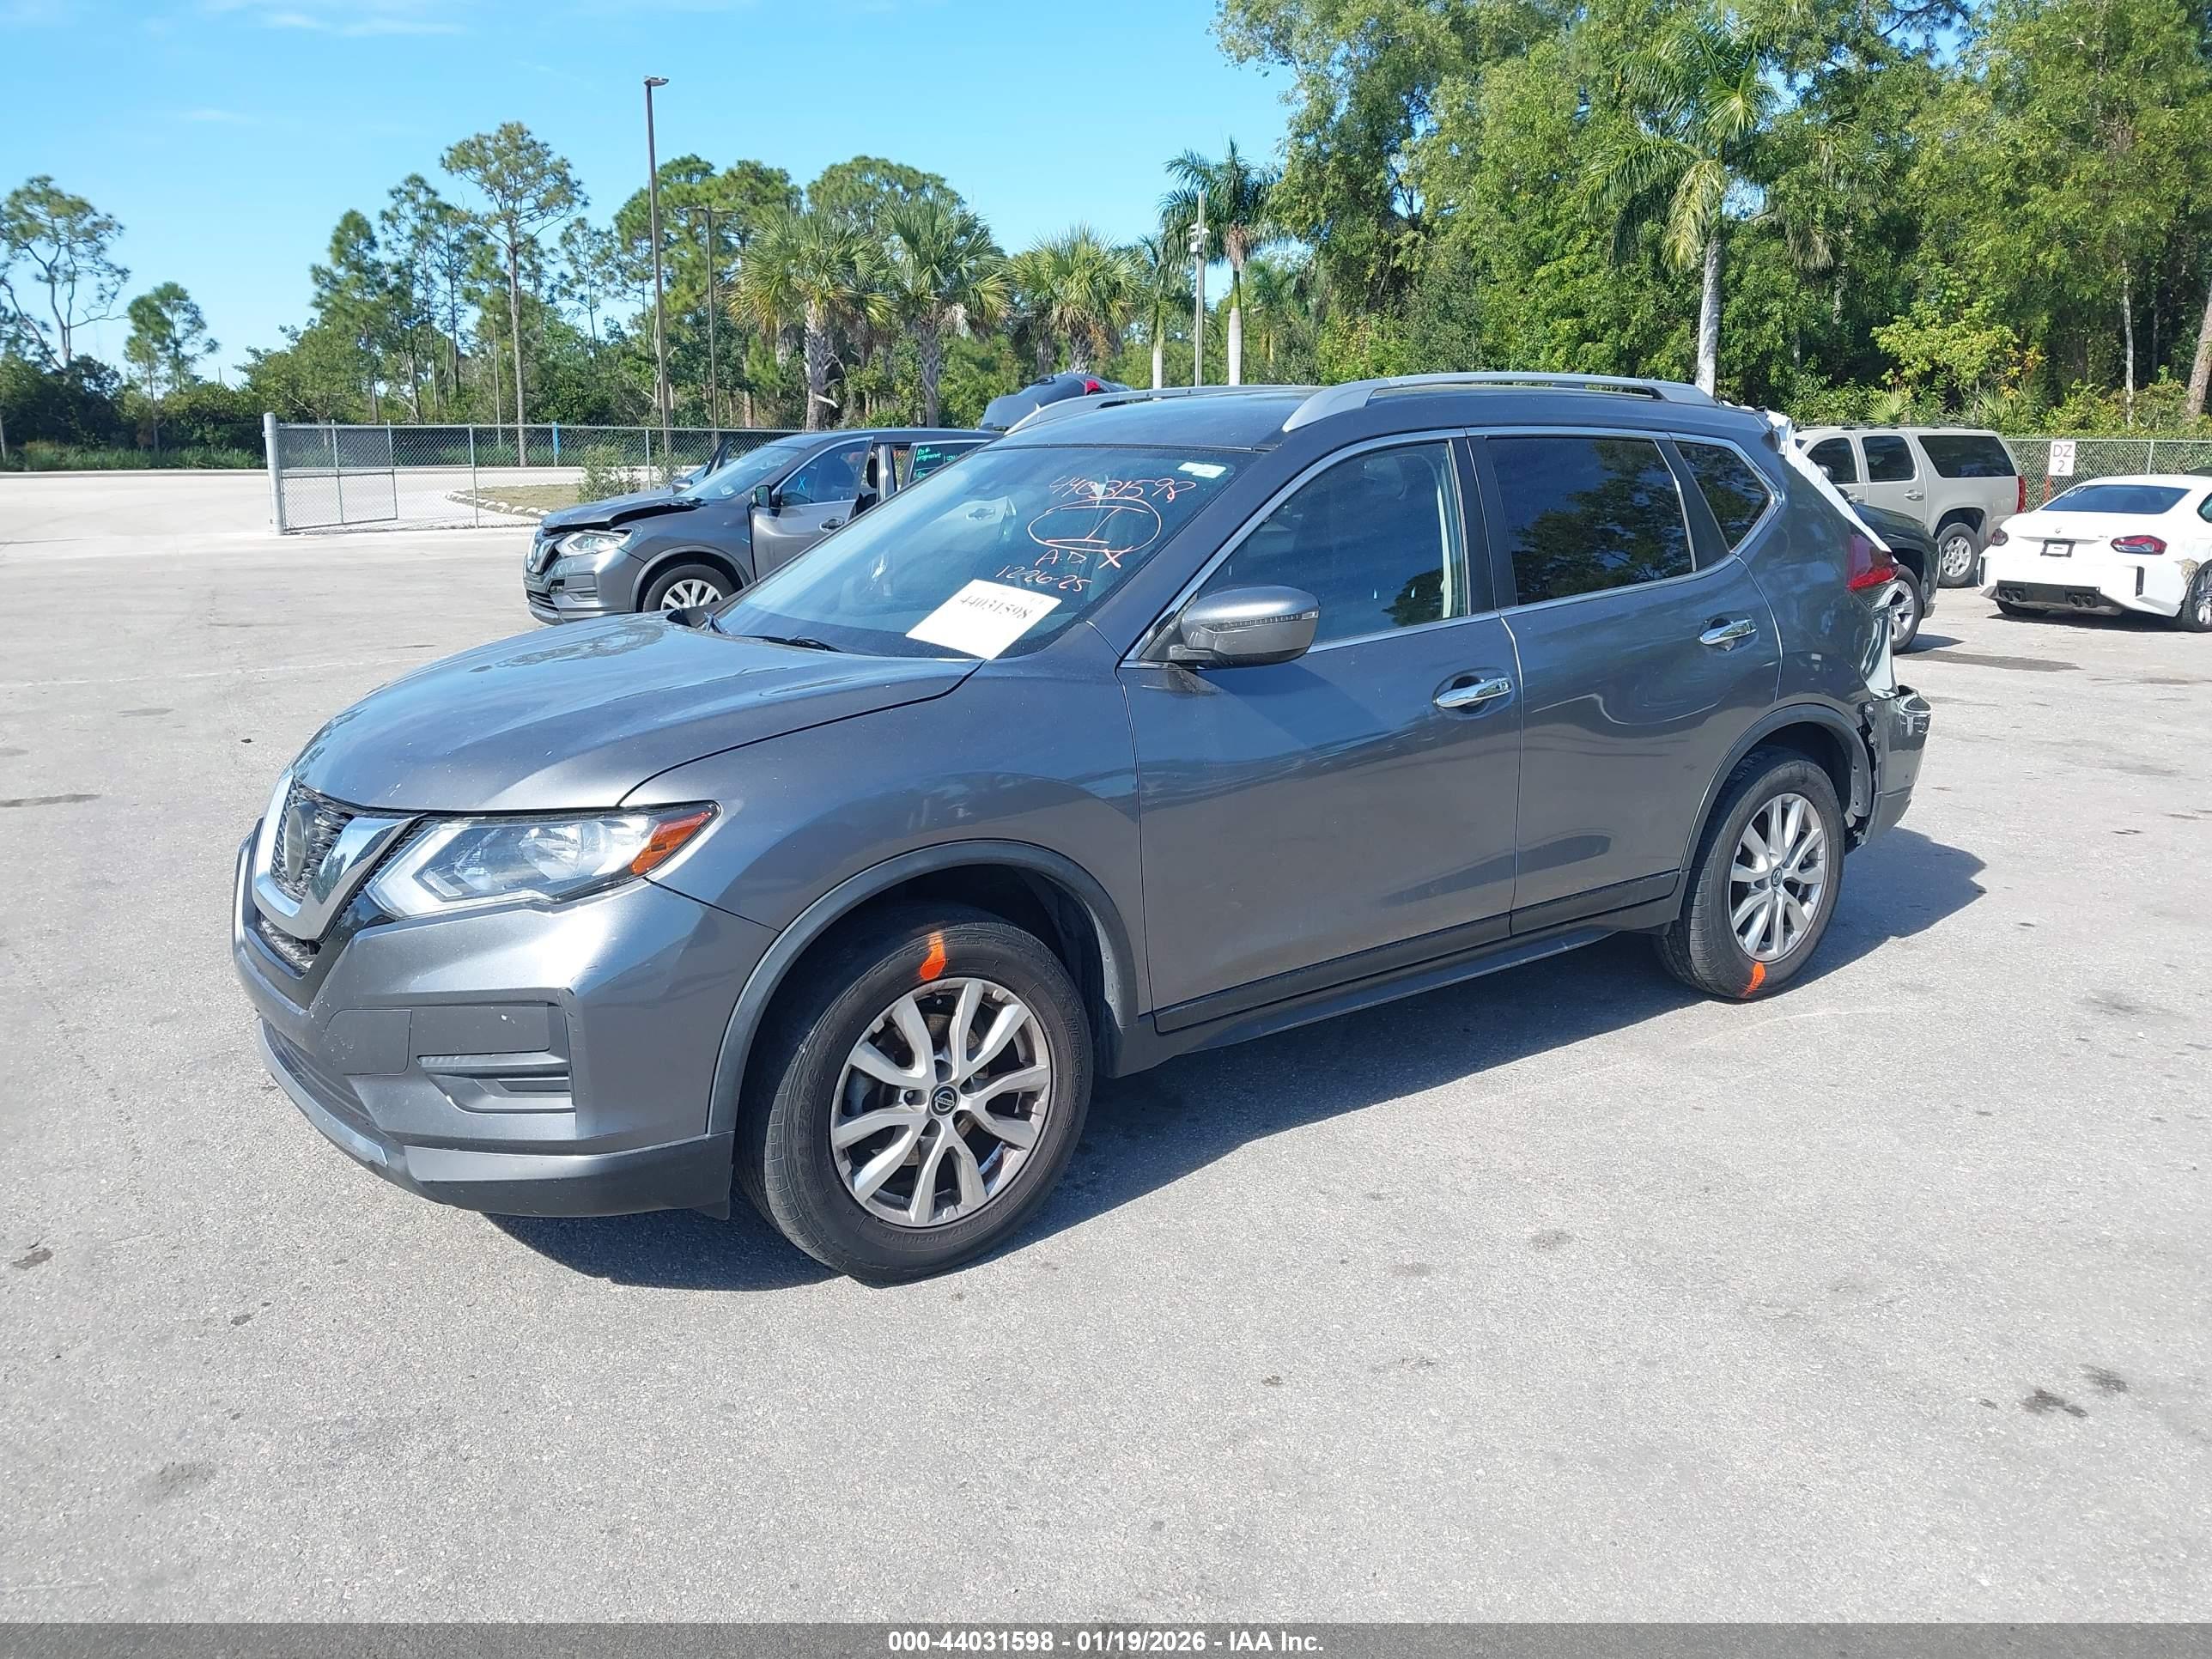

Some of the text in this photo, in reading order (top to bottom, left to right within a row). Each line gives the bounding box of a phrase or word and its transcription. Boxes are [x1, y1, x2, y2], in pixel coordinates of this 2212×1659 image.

[2052, 444, 2073, 458] DZ
[2057, 459, 2065, 472] 2
[1049, 475, 1197, 503] 44031598
[995, 564, 1093, 592] 12-26-25
